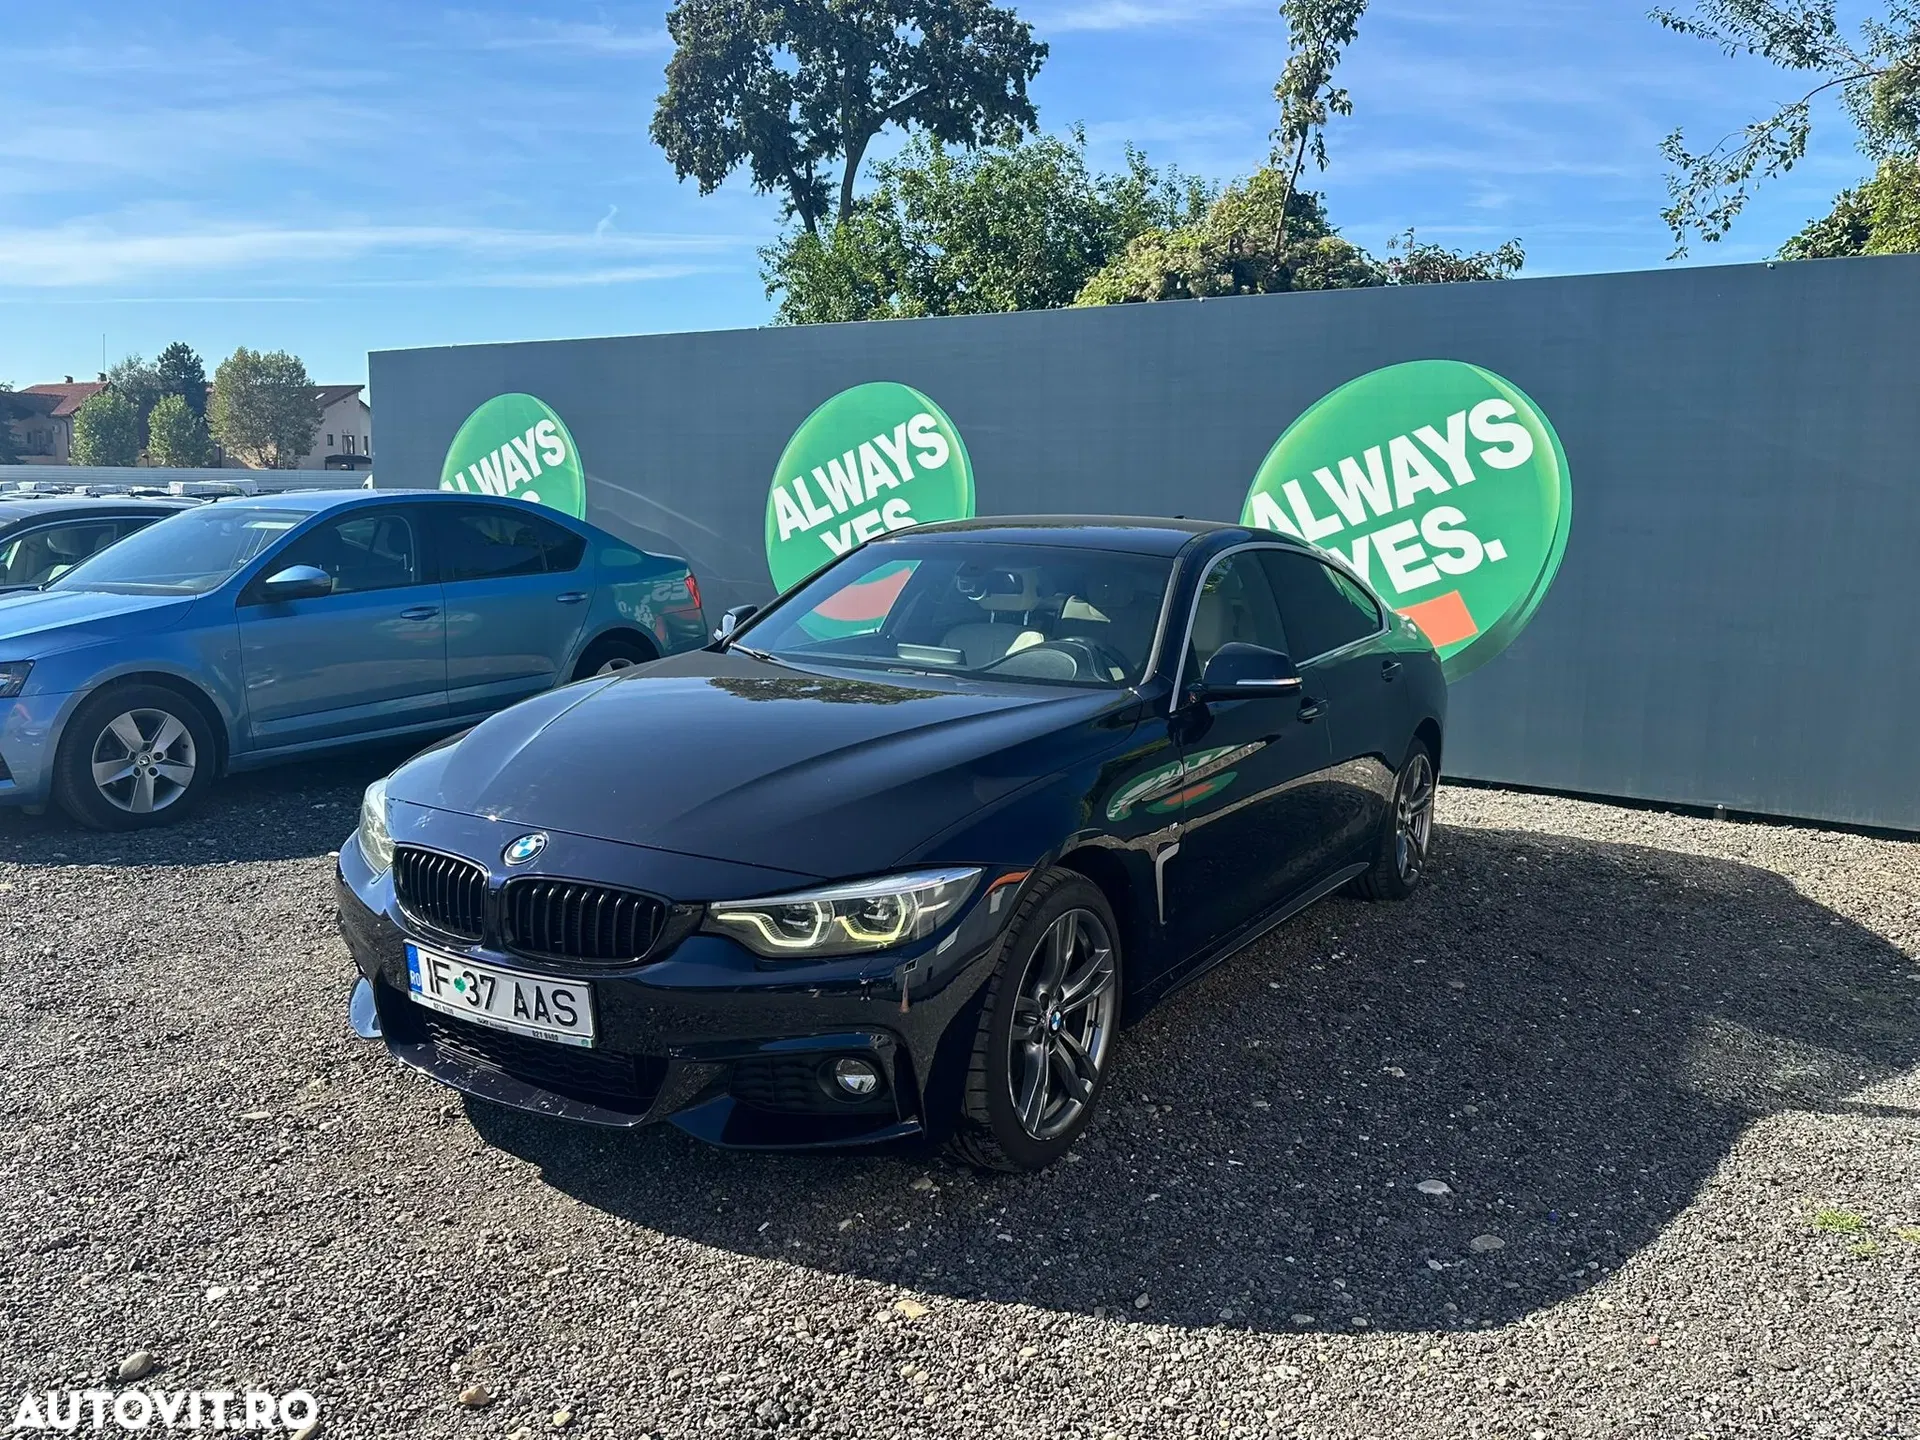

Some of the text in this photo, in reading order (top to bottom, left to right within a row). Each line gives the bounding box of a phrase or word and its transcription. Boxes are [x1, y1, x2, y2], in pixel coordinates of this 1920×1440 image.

[773, 413, 949, 542] ALWAYS
[409, 970, 422, 987] RO
[426, 957, 578, 1028] IF 37 AAS
